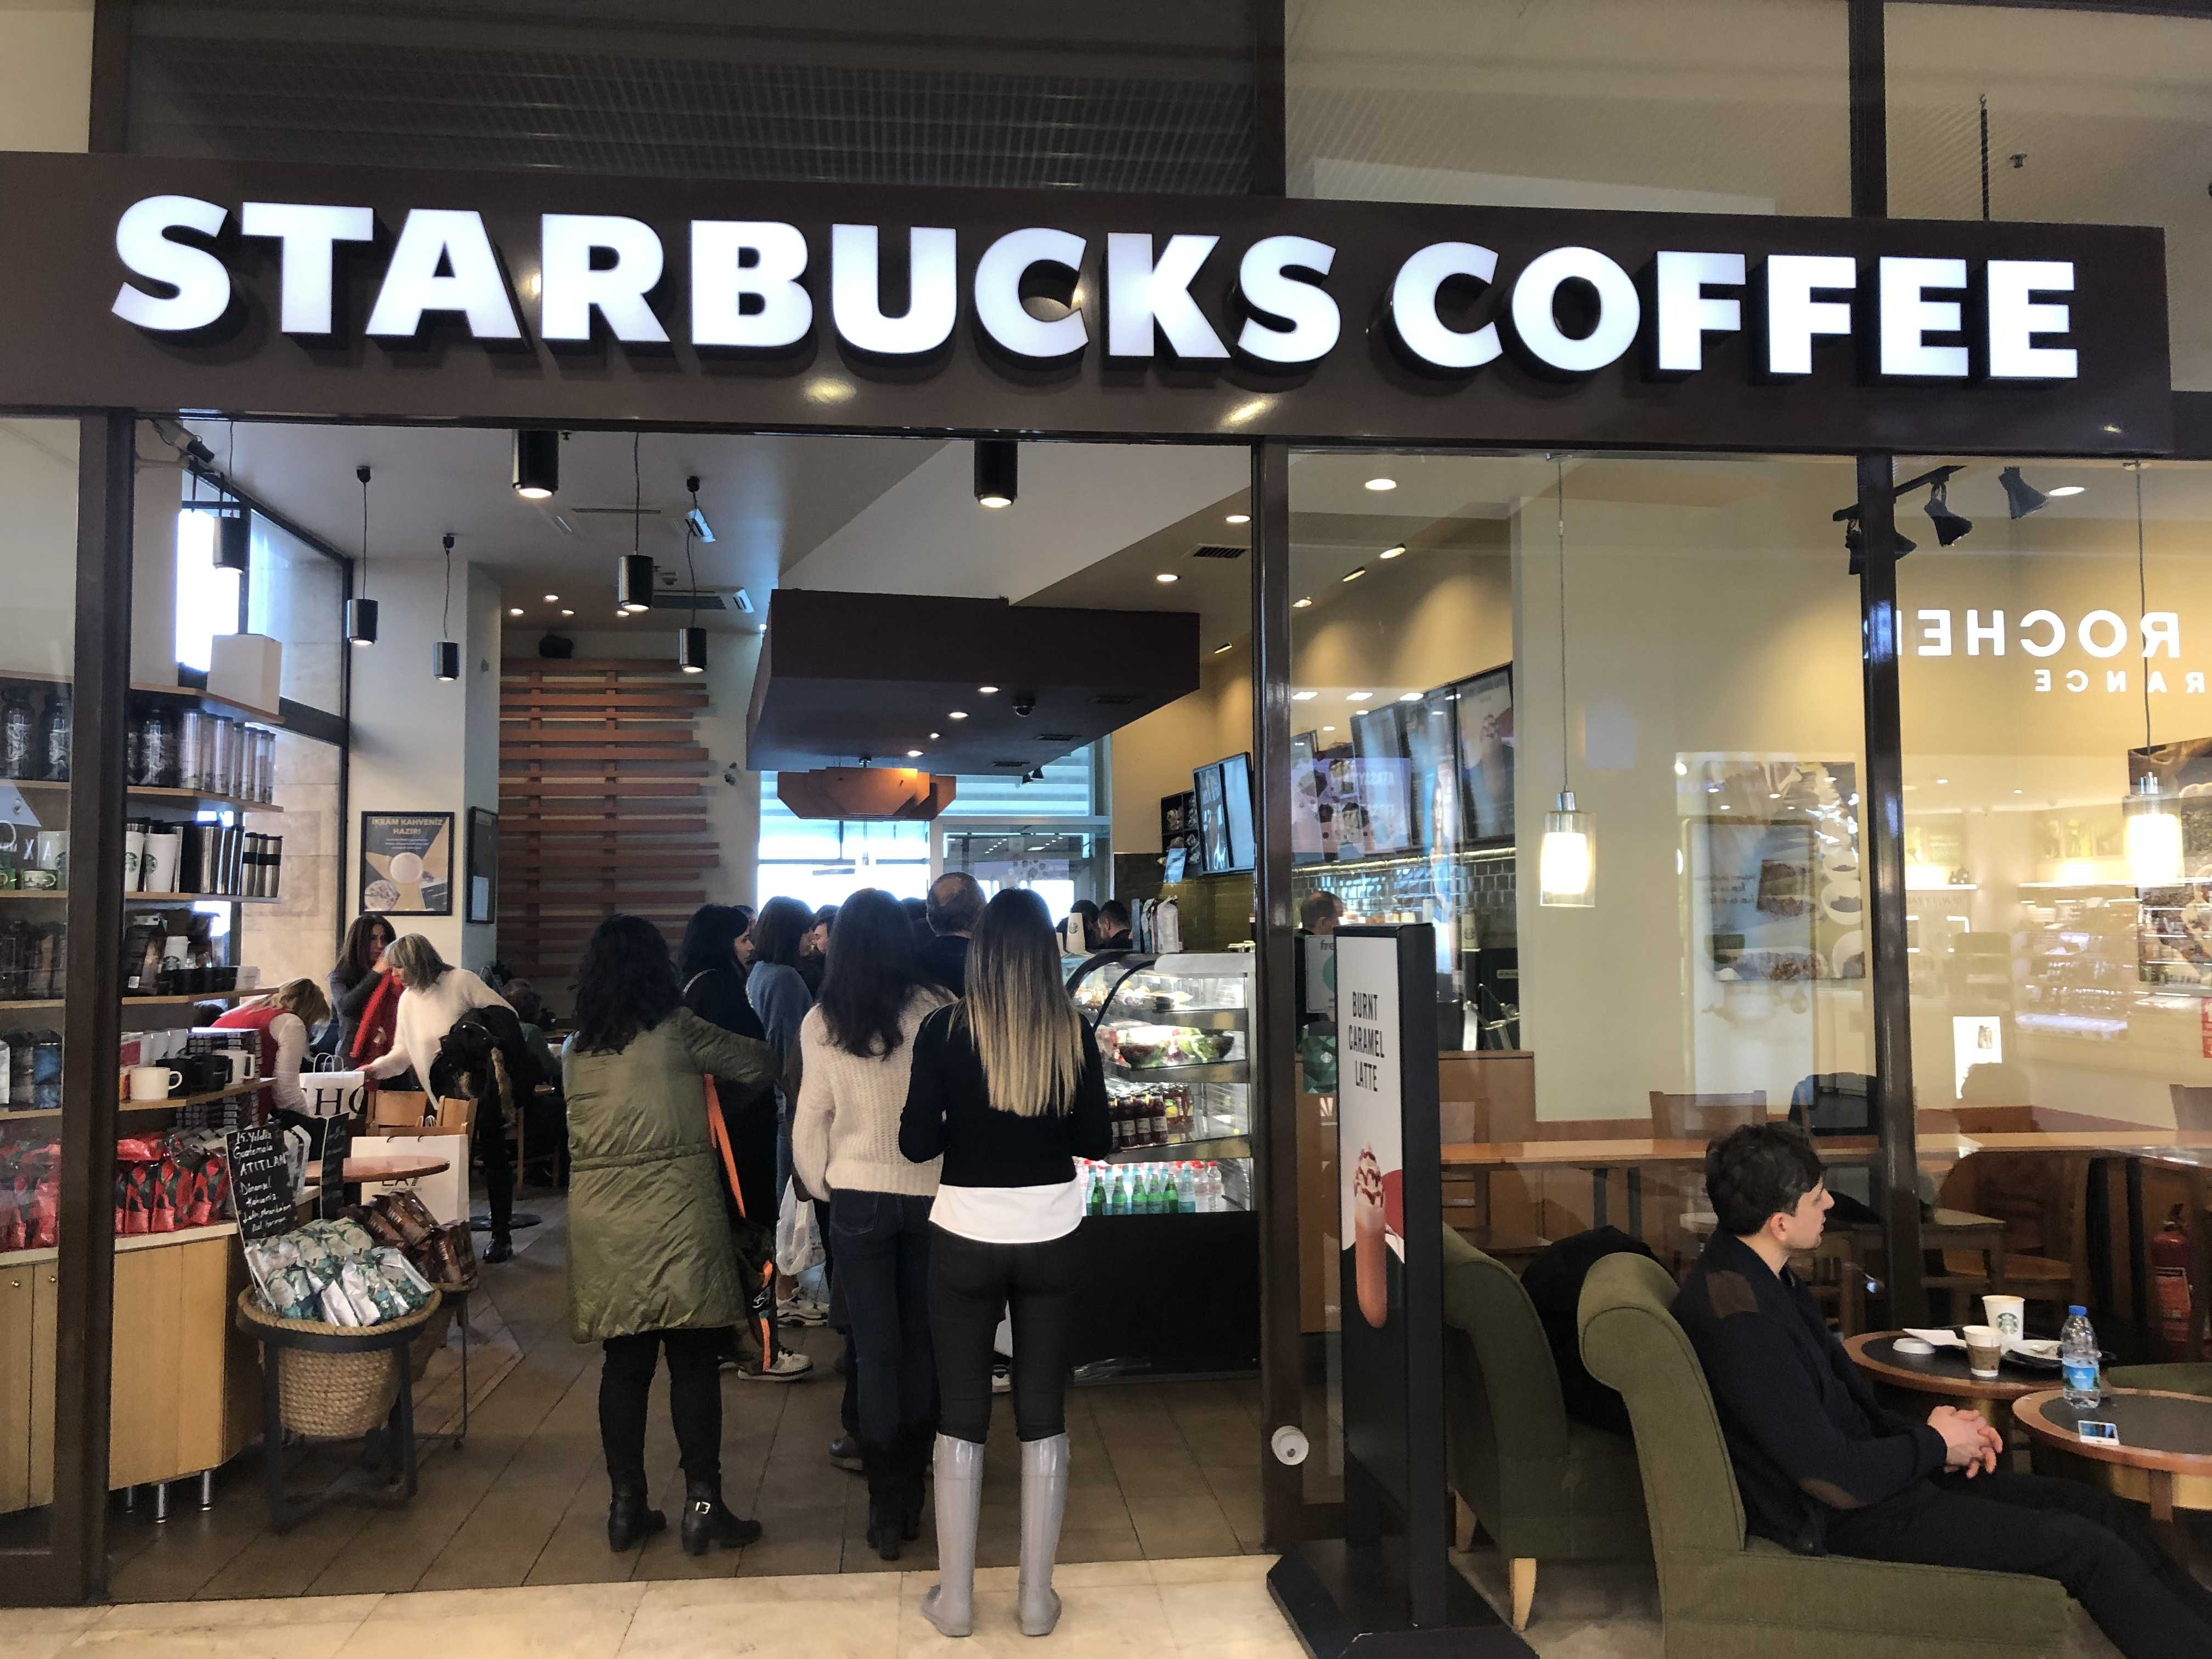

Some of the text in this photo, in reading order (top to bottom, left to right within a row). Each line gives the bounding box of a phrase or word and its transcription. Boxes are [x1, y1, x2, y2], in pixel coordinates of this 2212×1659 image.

[112, 195, 2078, 378] STARBUCKS COFFEE
[1352, 991, 1378, 1021] BURNT
[1348, 1024, 1385, 1058] CARAMEL
[1355, 1059, 1379, 1092] LATTE
[240, 1154, 286, 1177] ATITLAN
